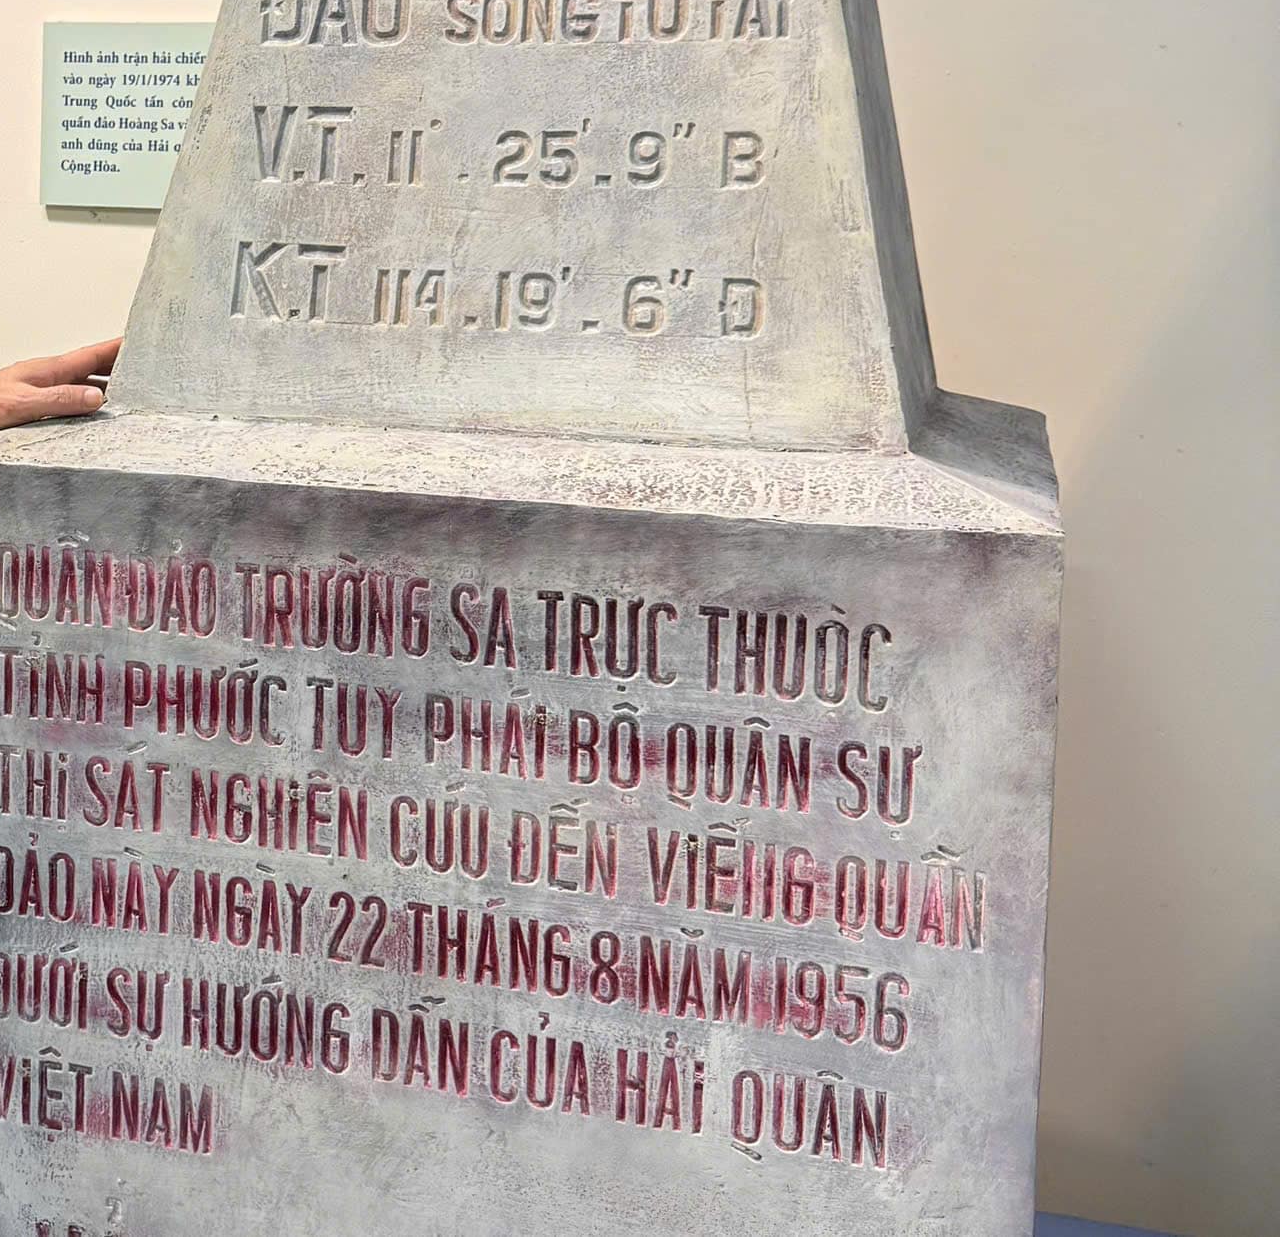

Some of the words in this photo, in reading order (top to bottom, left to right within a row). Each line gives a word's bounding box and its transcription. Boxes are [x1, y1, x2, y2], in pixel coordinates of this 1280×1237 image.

[63, 73, 82, 85] vào
[89, 74, 116, 88] ngày
[123, 74, 180, 86] 19/1/1974
[64, 51, 92, 64] Hình
[97, 51, 119, 64] ảnh
[123, 52, 148, 66] trận
[153, 52, 171, 64] hải
[62, 116, 90, 131] quần
[94, 116, 115, 129] đảo
[119, 117, 158, 132] Hoàng
[161, 118, 174, 130] Sa
[63, 95, 97, 108] Trung
[106, 95, 136, 109] Quốc
[145, 95, 164, 108] tấn
[172, 96, 193, 108] côn
[61, 139, 82, 150] anh
[88, 139, 118, 153] dũng
[123, 139, 142, 151] của
[148, 139, 168, 152] Hải
[61, 159, 91, 174] Cộng
[94, 160, 120, 172] Hòa.
[125, 539, 217, 639] ĐẢO
[235, 552, 431, 660] TRƯỜNG
[449, 582, 517, 669] SA
[538, 590, 679, 693] TRỰC
[124, 658, 287, 747] PHƯỚC
[307, 675, 401, 762] TUY
[426, 688, 546, 780] PHÁI
[666, 716, 812, 815] QUÂN
[837, 738, 923, 841] SỰ
[83, 741, 171, 835] SÁT
[190, 770, 368, 861] NGHIÊN
[508, 798, 618, 900] ĐẾN
[91, 847, 180, 936] NÀY
[193, 863, 312, 957] NGÀY
[327, 890, 389, 970] 22
[407, 897, 573, 999] THÁNG
[589, 930, 622, 1006] 8
[638, 927, 753, 1027] NĂM
[774, 955, 912, 1054] 1956
[106, 967, 171, 1052] SỰ
[182, 974, 351, 1076] HƯỚNG
[371, 995, 471, 1100] DẪN
[489, 1011, 592, 1118] CỦA
[615, 1030, 706, 1135] HẢI
[730, 1070, 889, 1171] QUÂN
[111, 1070, 215, 1156] NAM
